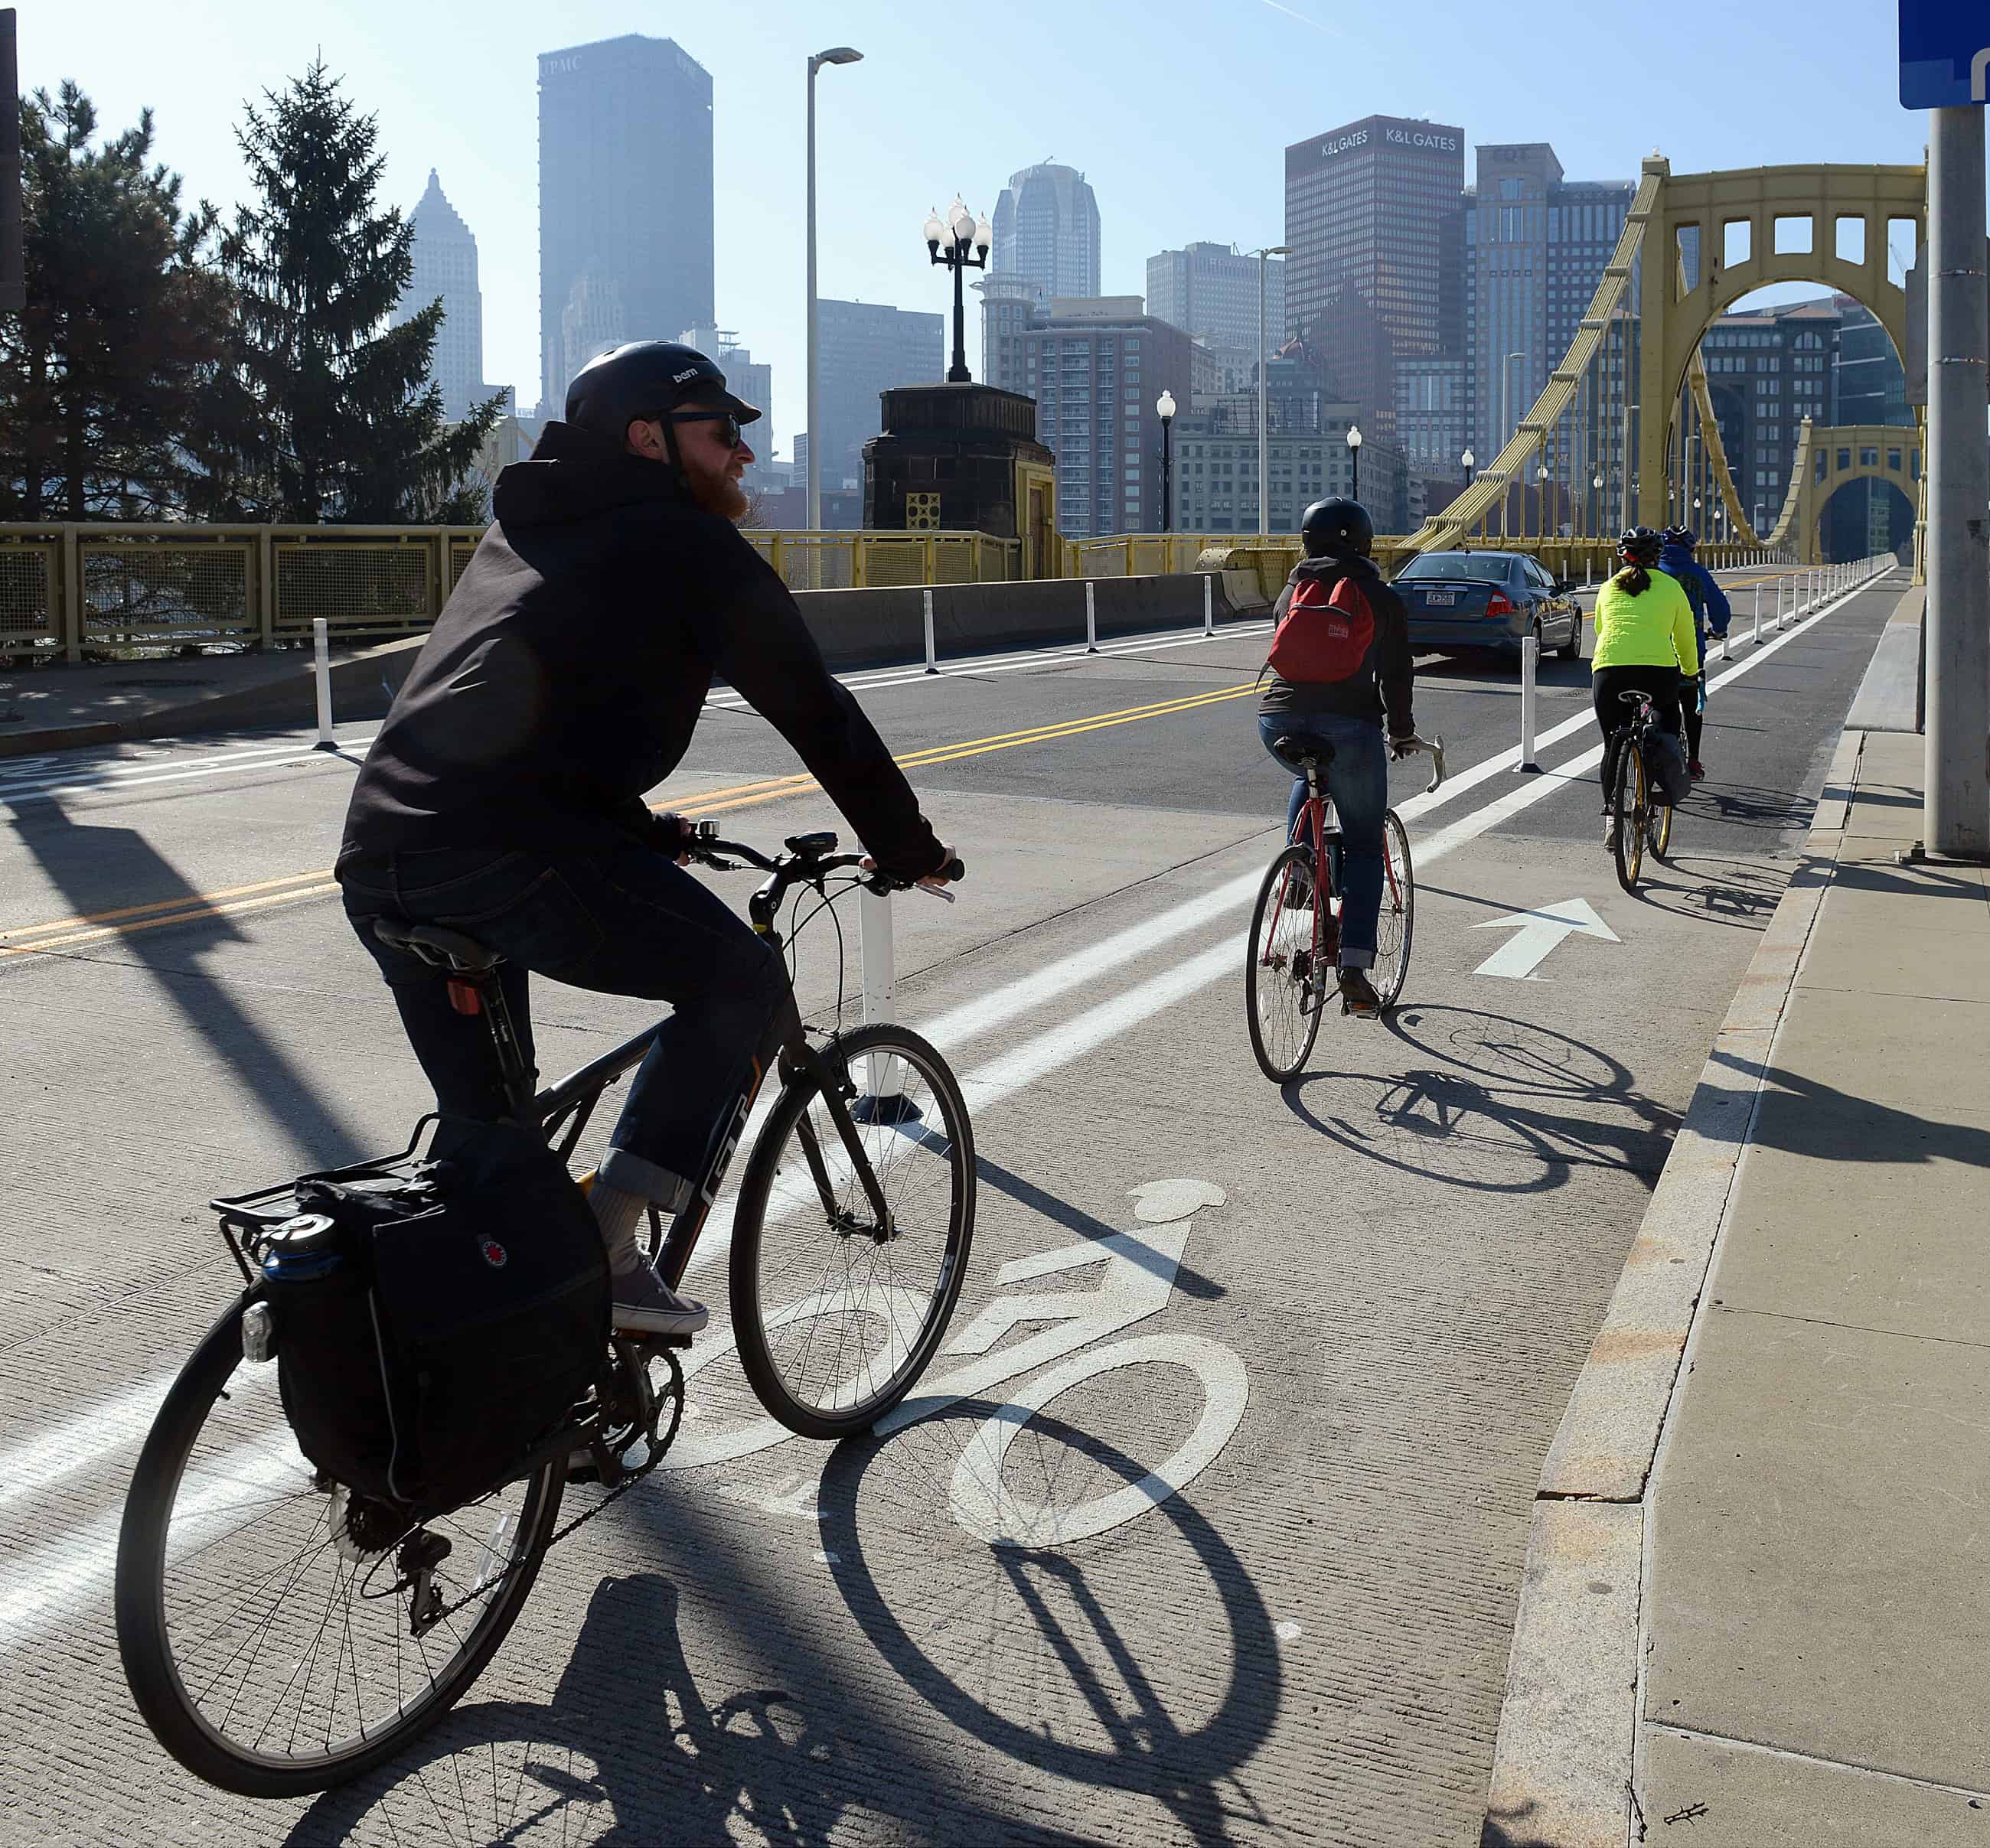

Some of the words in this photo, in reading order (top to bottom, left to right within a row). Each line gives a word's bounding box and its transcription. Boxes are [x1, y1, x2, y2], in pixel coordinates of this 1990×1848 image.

[1322, 141, 1339, 157] K&L
[1339, 130, 1368, 151] GATES
[1386, 129, 1411, 144] K&L
[1414, 133, 1456, 152] GATES
